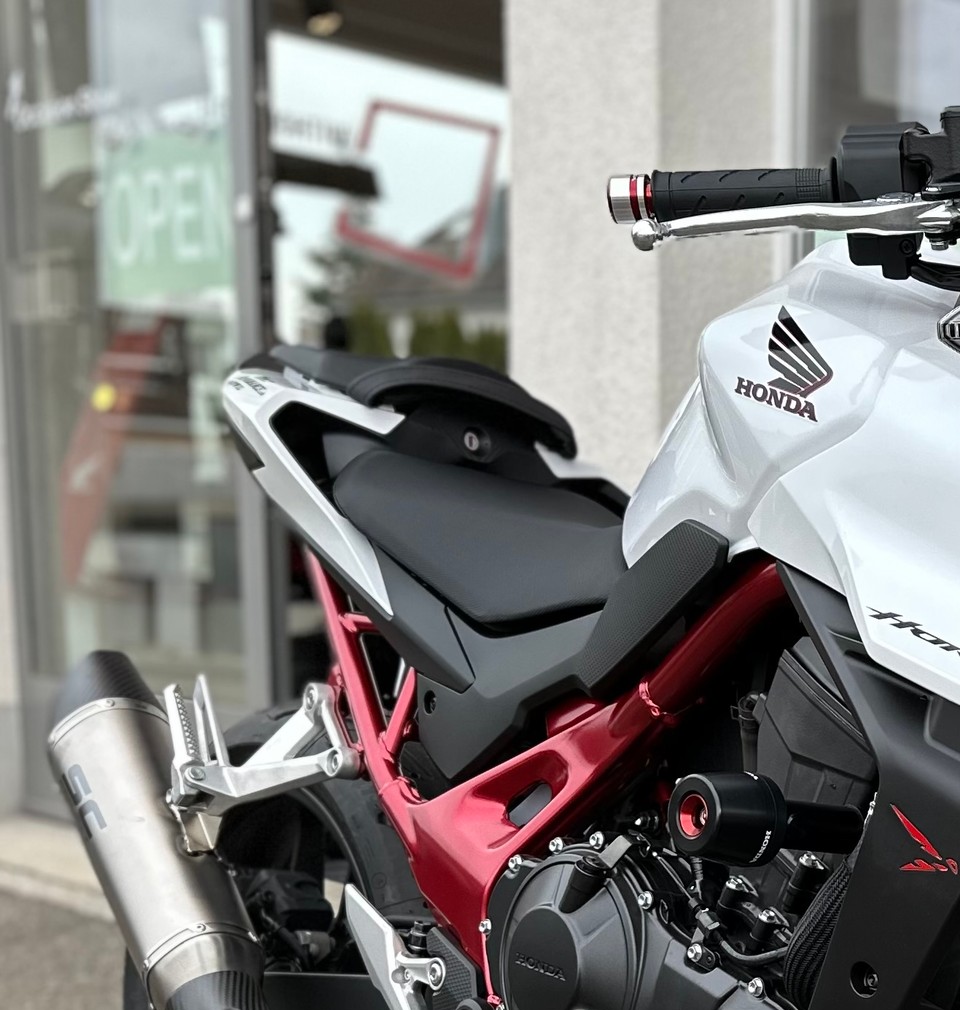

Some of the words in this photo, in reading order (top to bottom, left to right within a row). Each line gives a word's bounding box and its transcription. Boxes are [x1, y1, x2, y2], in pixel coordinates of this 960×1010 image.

[106, 163, 232, 267] OPEN
[733, 376, 819, 423] HONDA
[515, 952, 566, 981] HONDA
